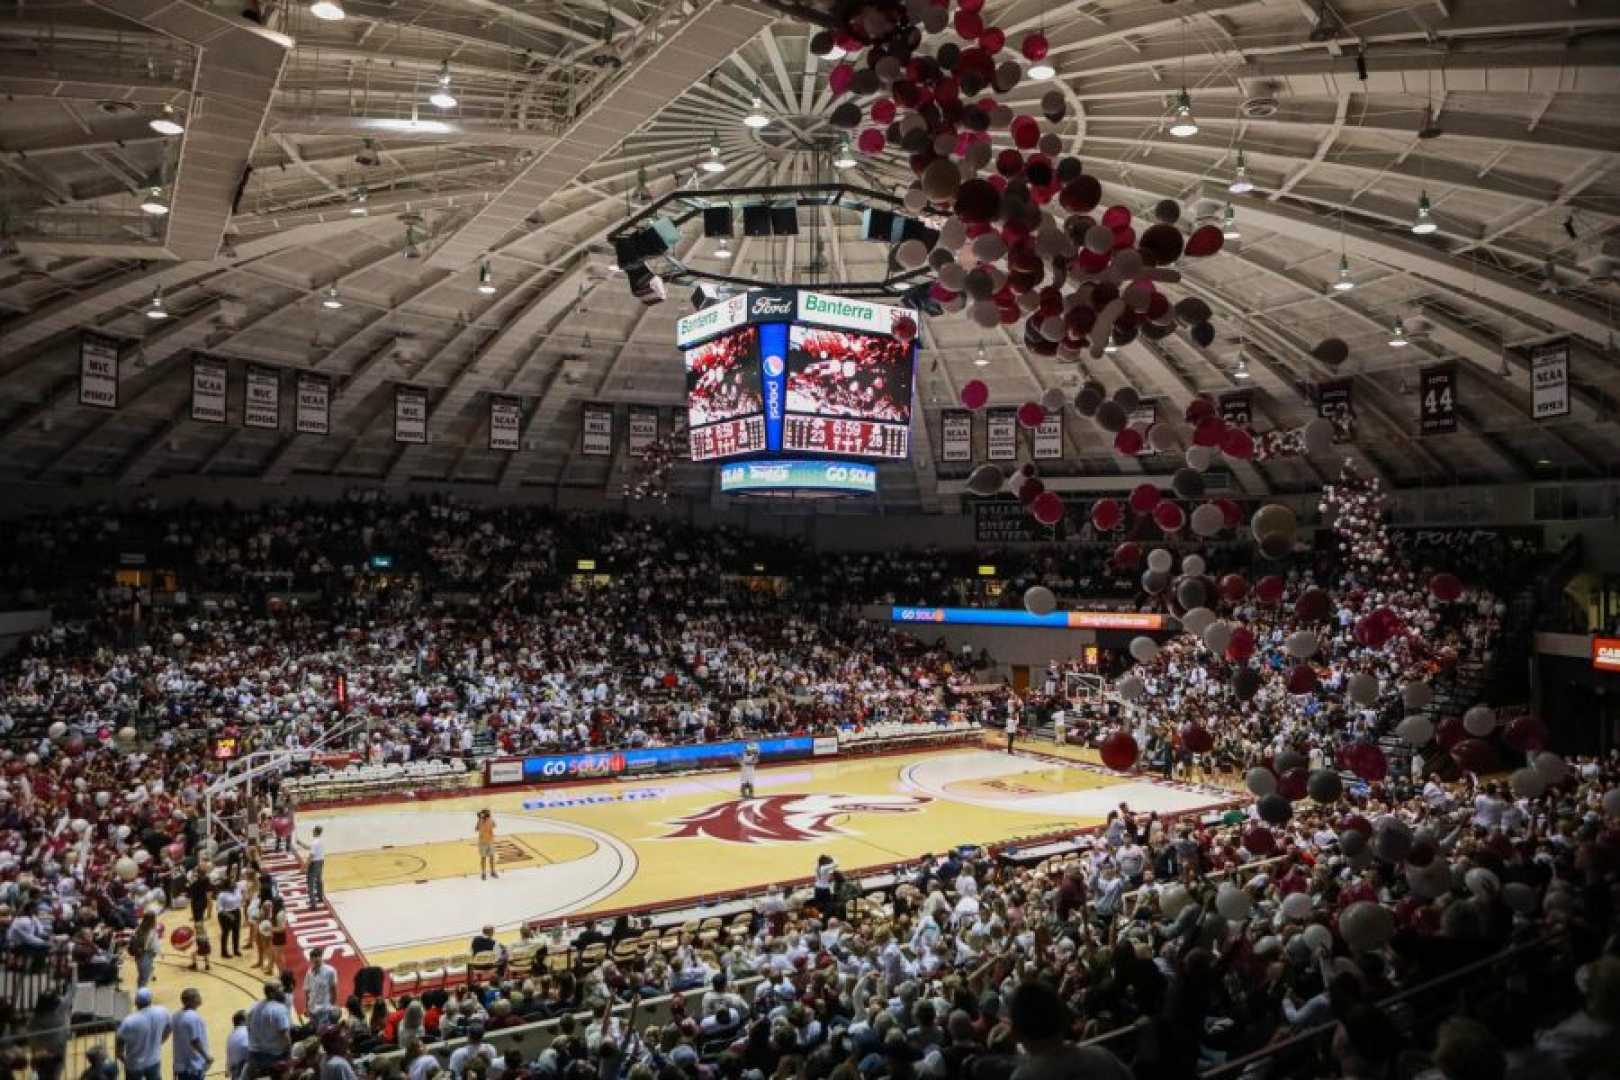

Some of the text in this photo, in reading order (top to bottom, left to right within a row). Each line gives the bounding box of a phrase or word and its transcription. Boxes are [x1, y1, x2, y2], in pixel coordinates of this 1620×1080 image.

[752, 296, 793, 315] Ford
[806, 295, 874, 321] Banterra
[681, 310, 719, 336] Banterra
[1424, 385, 1454, 415] 44
[826, 467, 847, 481] GO
[543, 760, 566, 777] GO
